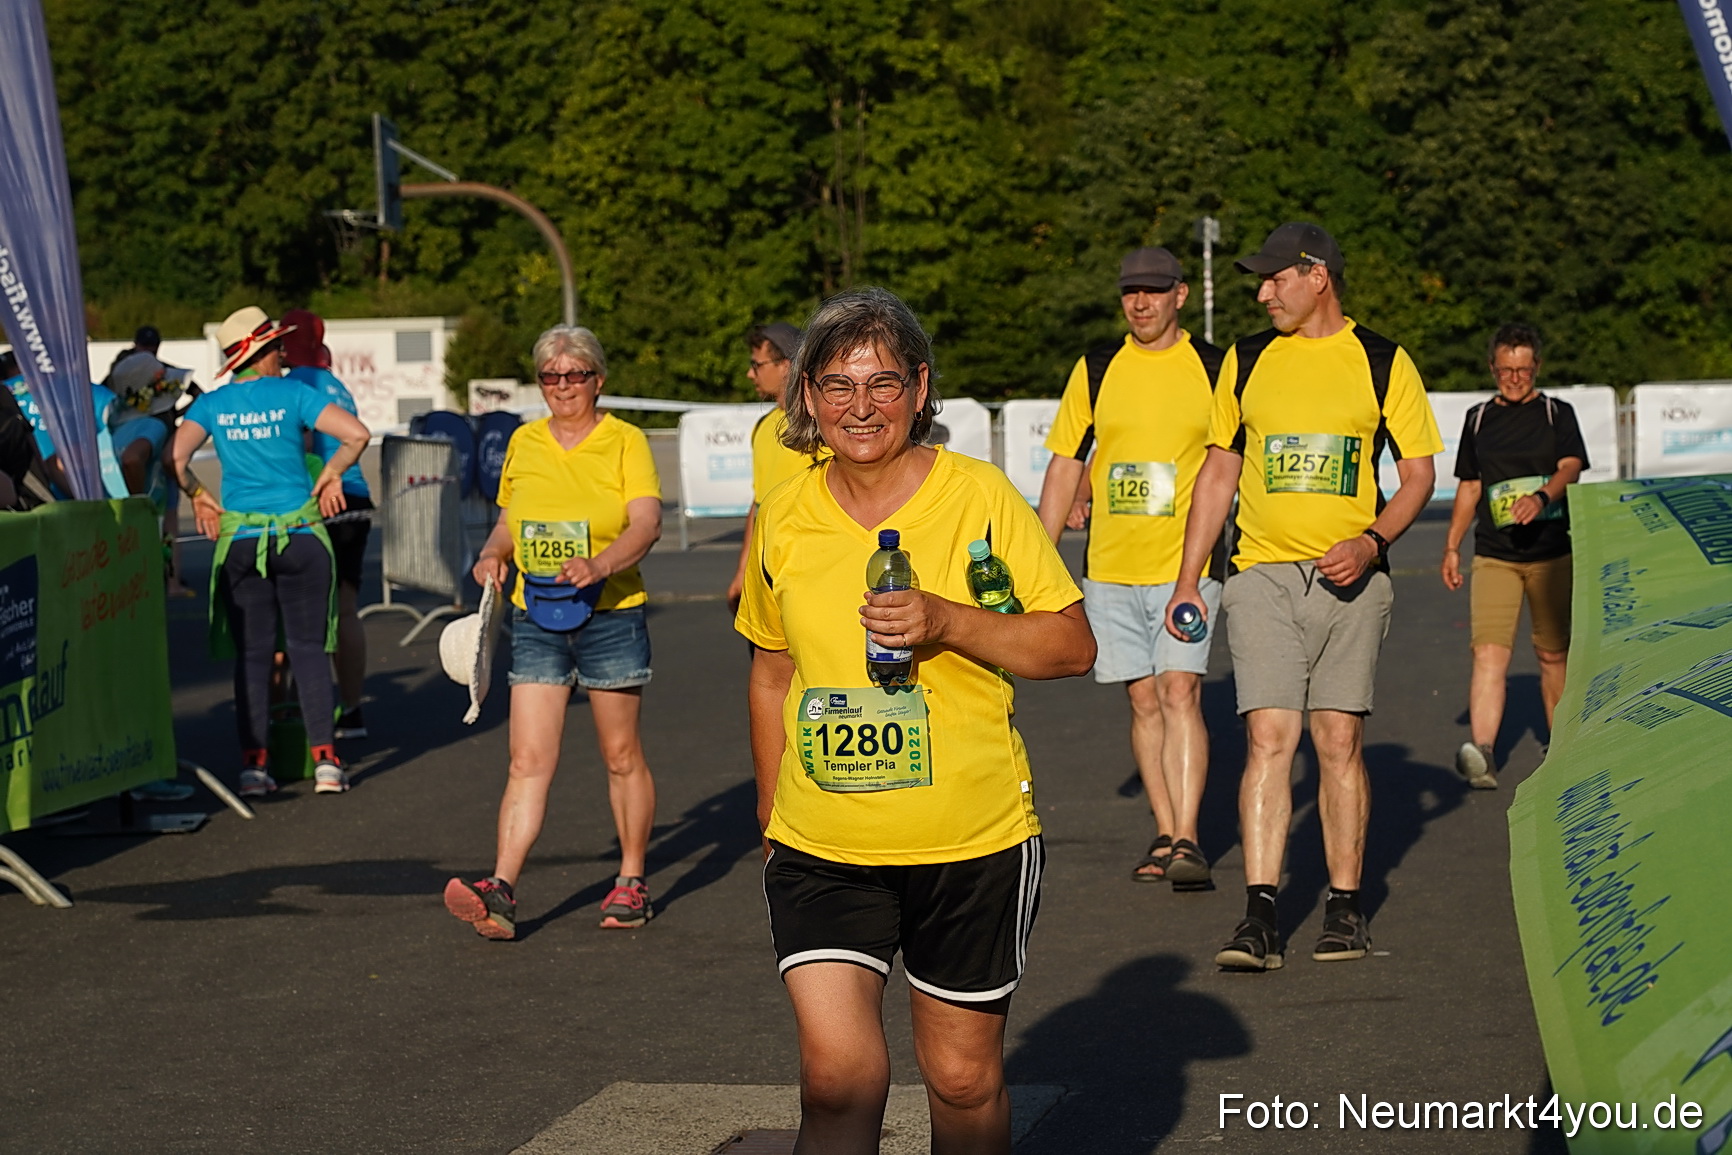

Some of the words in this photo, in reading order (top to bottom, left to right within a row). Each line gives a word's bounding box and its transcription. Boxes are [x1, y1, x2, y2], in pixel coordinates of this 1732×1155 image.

[1276, 453, 1330, 473] 1257
[1331, 458, 1339, 485] 2022
[530, 540, 575, 558] 1285
[824, 705, 863, 715] Firmenlauf
[803, 727, 815, 775] WALK
[815, 722, 904, 757] 1280
[908, 726, 921, 772] 2022
[824, 760, 872, 774] Templer
[875, 760, 896, 770] Pia
